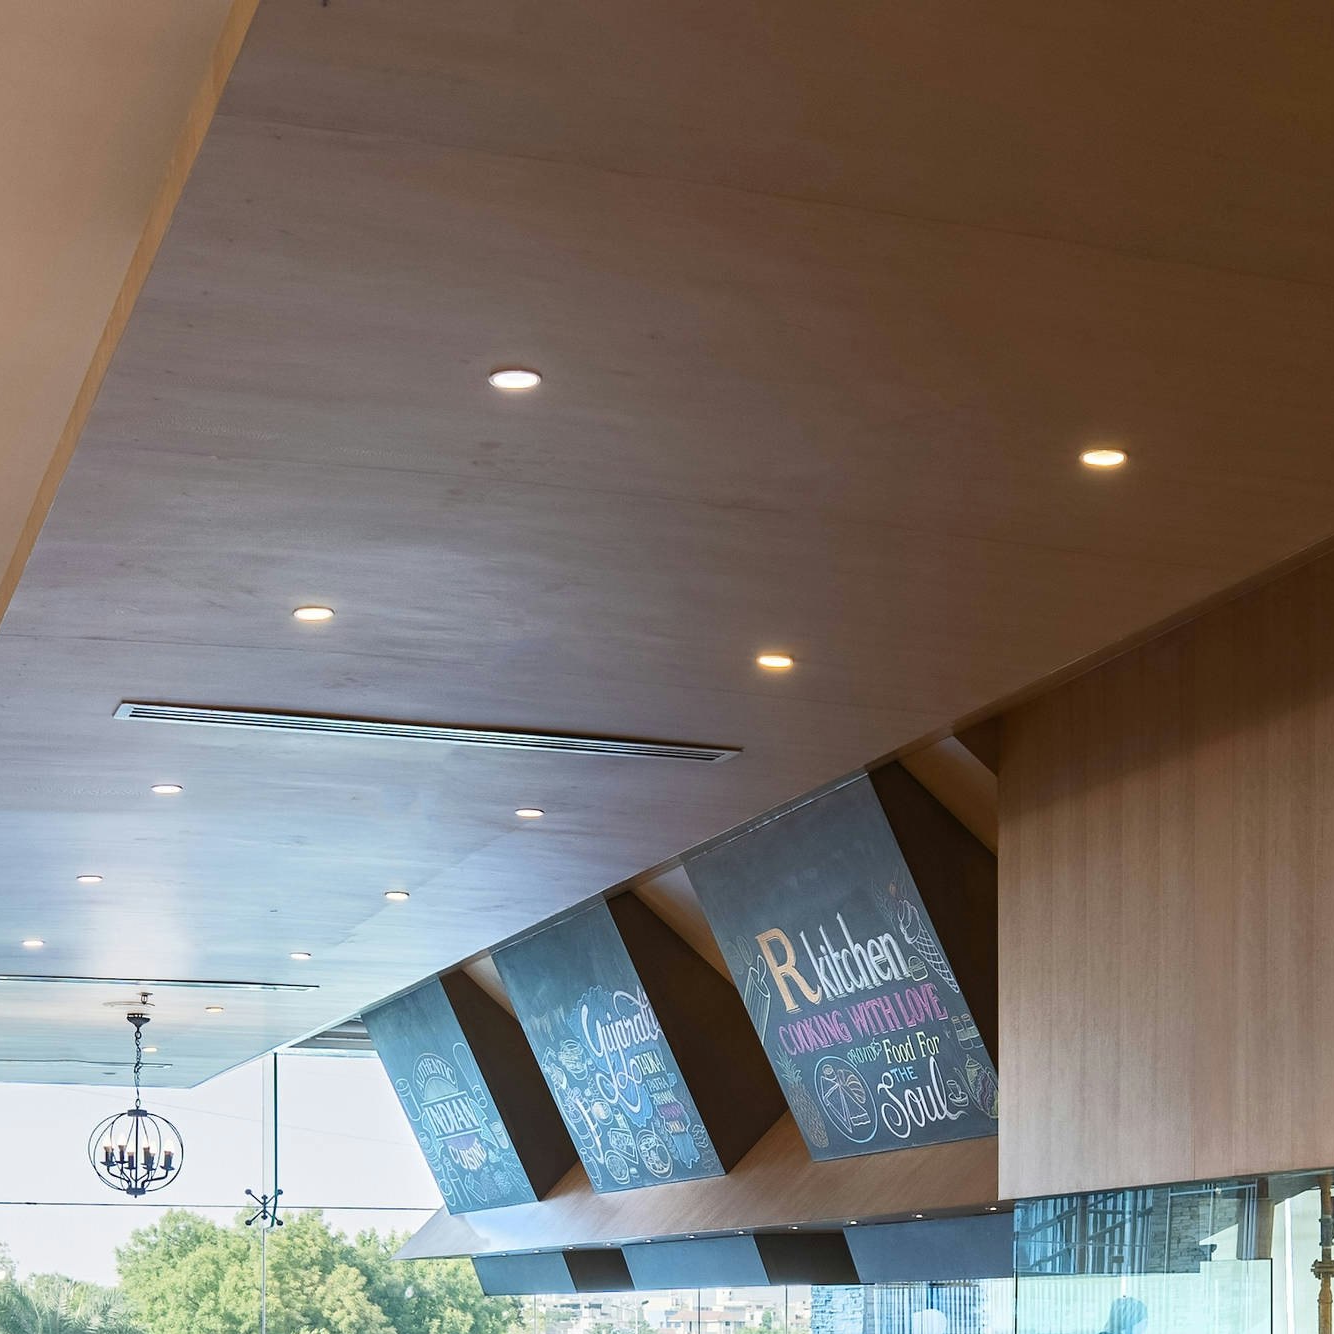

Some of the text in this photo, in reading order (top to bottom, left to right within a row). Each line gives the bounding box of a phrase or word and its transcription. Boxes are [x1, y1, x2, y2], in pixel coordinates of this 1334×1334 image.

[755, 911, 912, 1014] R kitchen
[778, 982, 948, 1056] COOKING WITH LOVE
[882, 1035, 917, 1065] Food
[916, 1031, 940, 1057] For
[890, 1065, 917, 1082] THE
[425, 1096, 479, 1136] INDIAN
[877, 1056, 968, 1138] Soul
